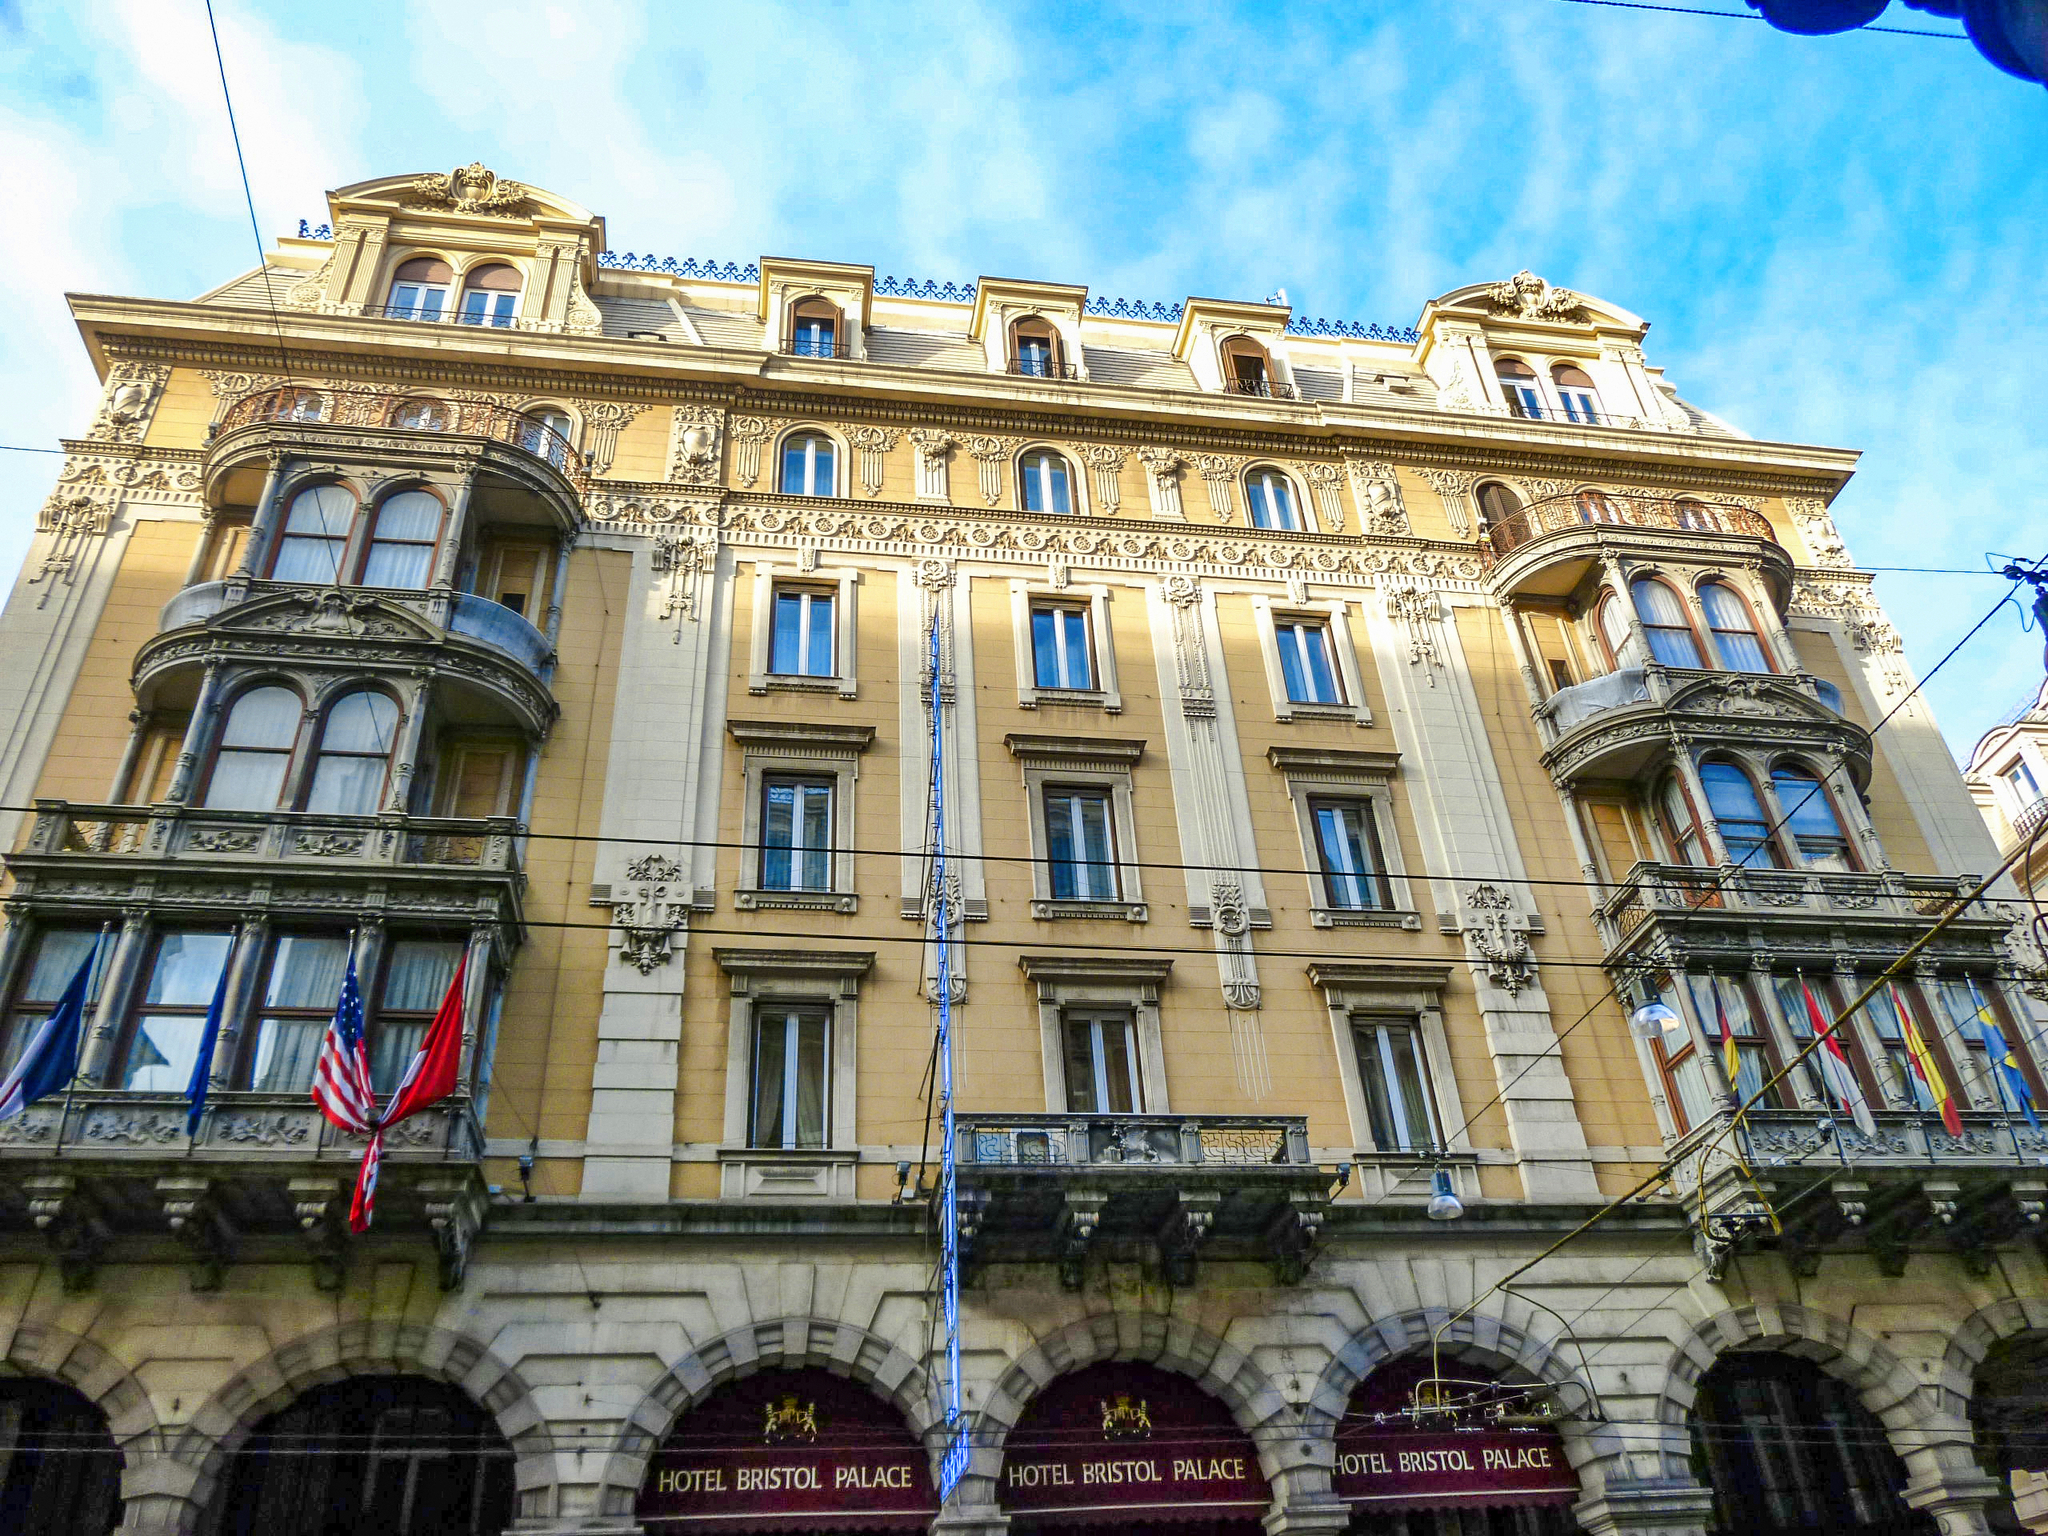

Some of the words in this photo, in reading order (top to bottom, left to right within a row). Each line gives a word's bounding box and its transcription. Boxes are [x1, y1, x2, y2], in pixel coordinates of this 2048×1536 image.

[1008, 1464, 1074, 1487] HOTEL
[1082, 1460, 1162, 1484] BRISTOL
[1173, 1459, 1245, 1481] PALACE
[1332, 1453, 1392, 1476] HOTEL
[1398, 1450, 1474, 1473] BRISTOL
[1482, 1448, 1551, 1470] PALACE
[659, 1469, 727, 1492] HOTEL
[737, 1467, 822, 1490] BRISTOL
[835, 1466, 912, 1489] PALACE
